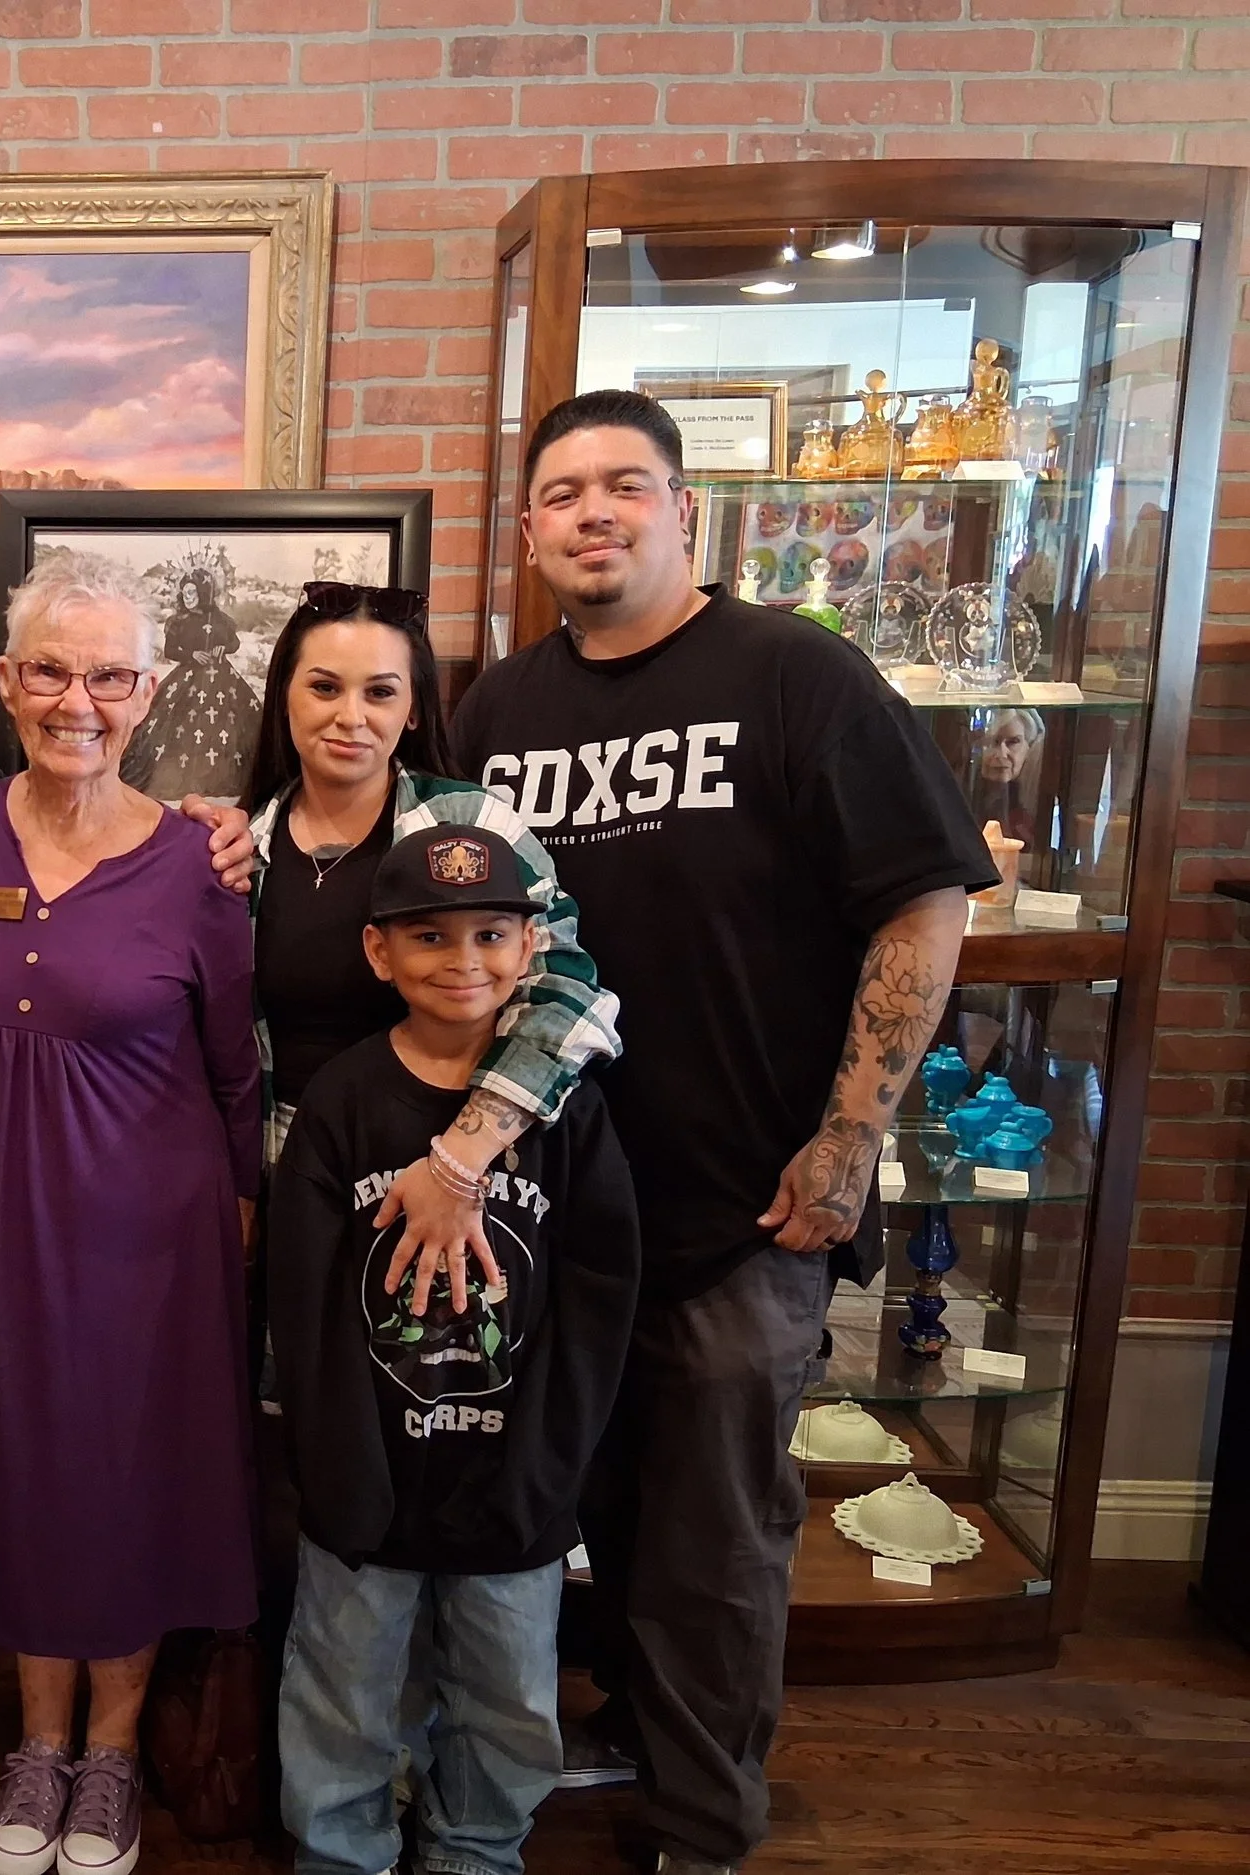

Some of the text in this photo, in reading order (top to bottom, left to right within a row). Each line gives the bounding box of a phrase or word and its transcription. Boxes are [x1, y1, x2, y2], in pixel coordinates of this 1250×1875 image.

[482, 721, 740, 828] SDXSE
[542, 836, 576, 846] DIEGO
[590, 824, 632, 843] STRAIGHT
[636, 820, 663, 832] EDGE
